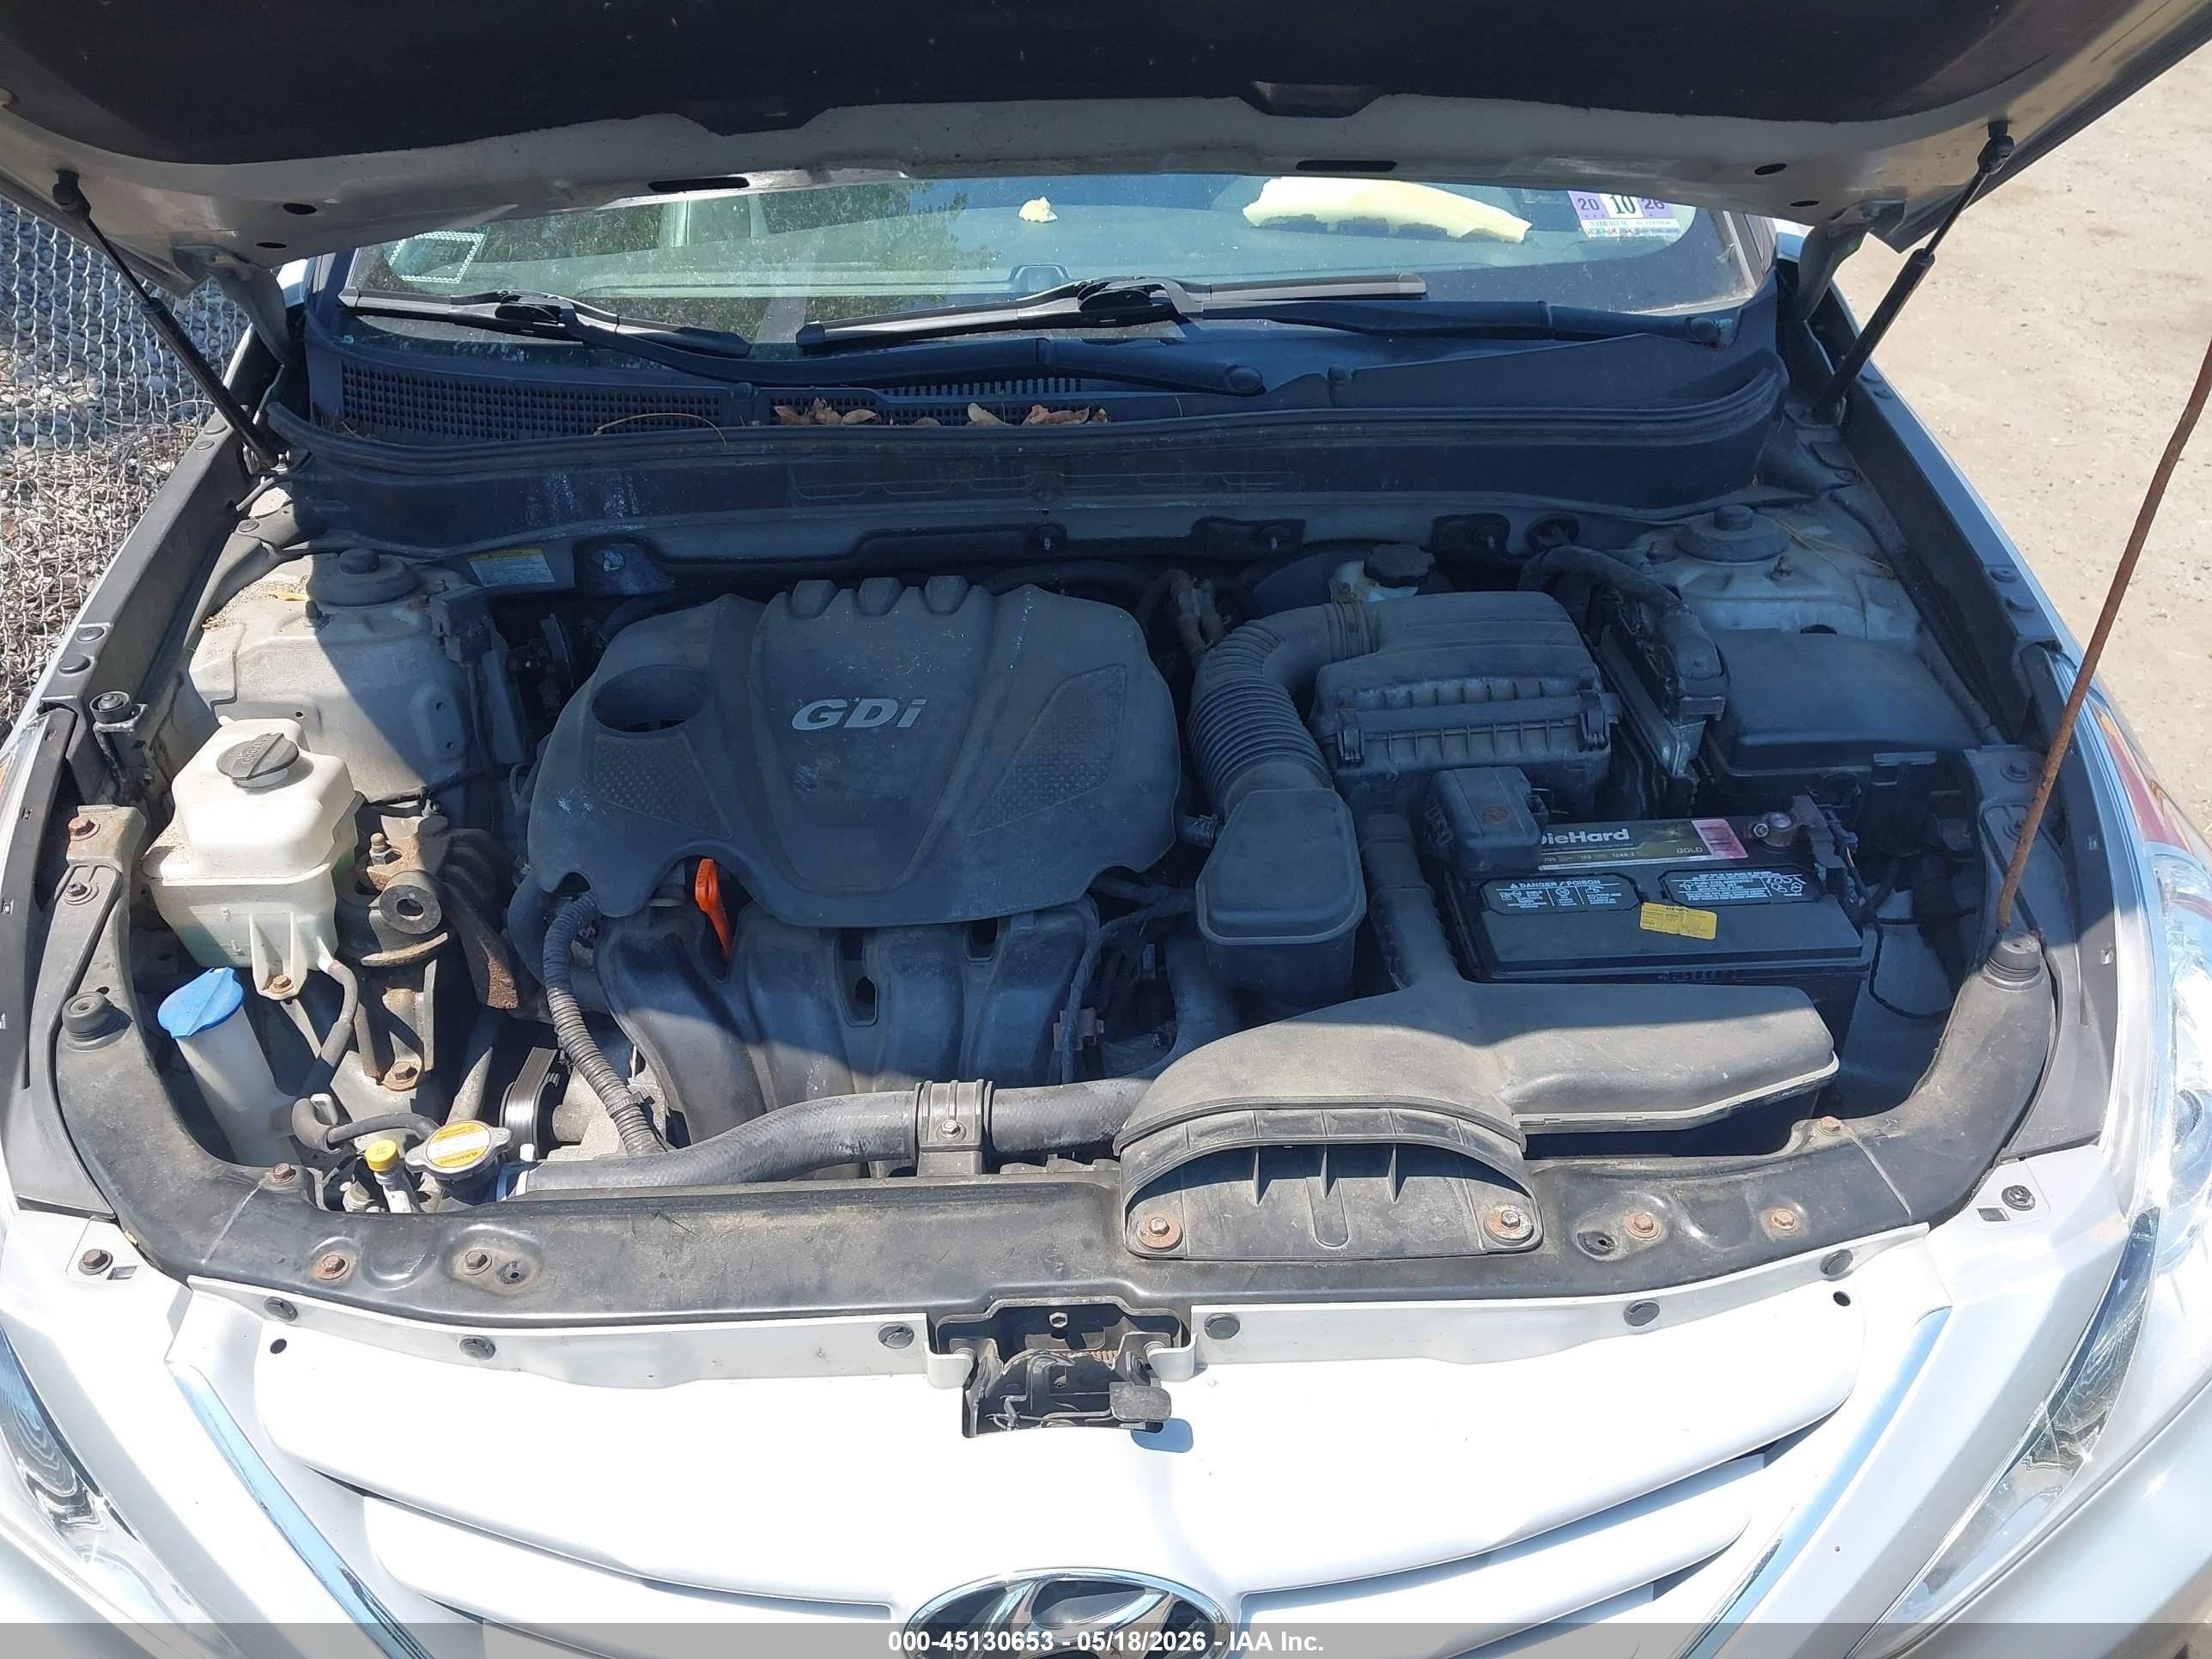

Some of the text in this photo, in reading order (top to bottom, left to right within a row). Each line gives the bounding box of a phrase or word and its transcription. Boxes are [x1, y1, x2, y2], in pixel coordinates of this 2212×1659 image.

[1577, 198, 1600, 210] 20
[1609, 194, 1636, 214] 10
[792, 699, 927, 730] GDi
[1676, 846, 1704, 854] GOLD
